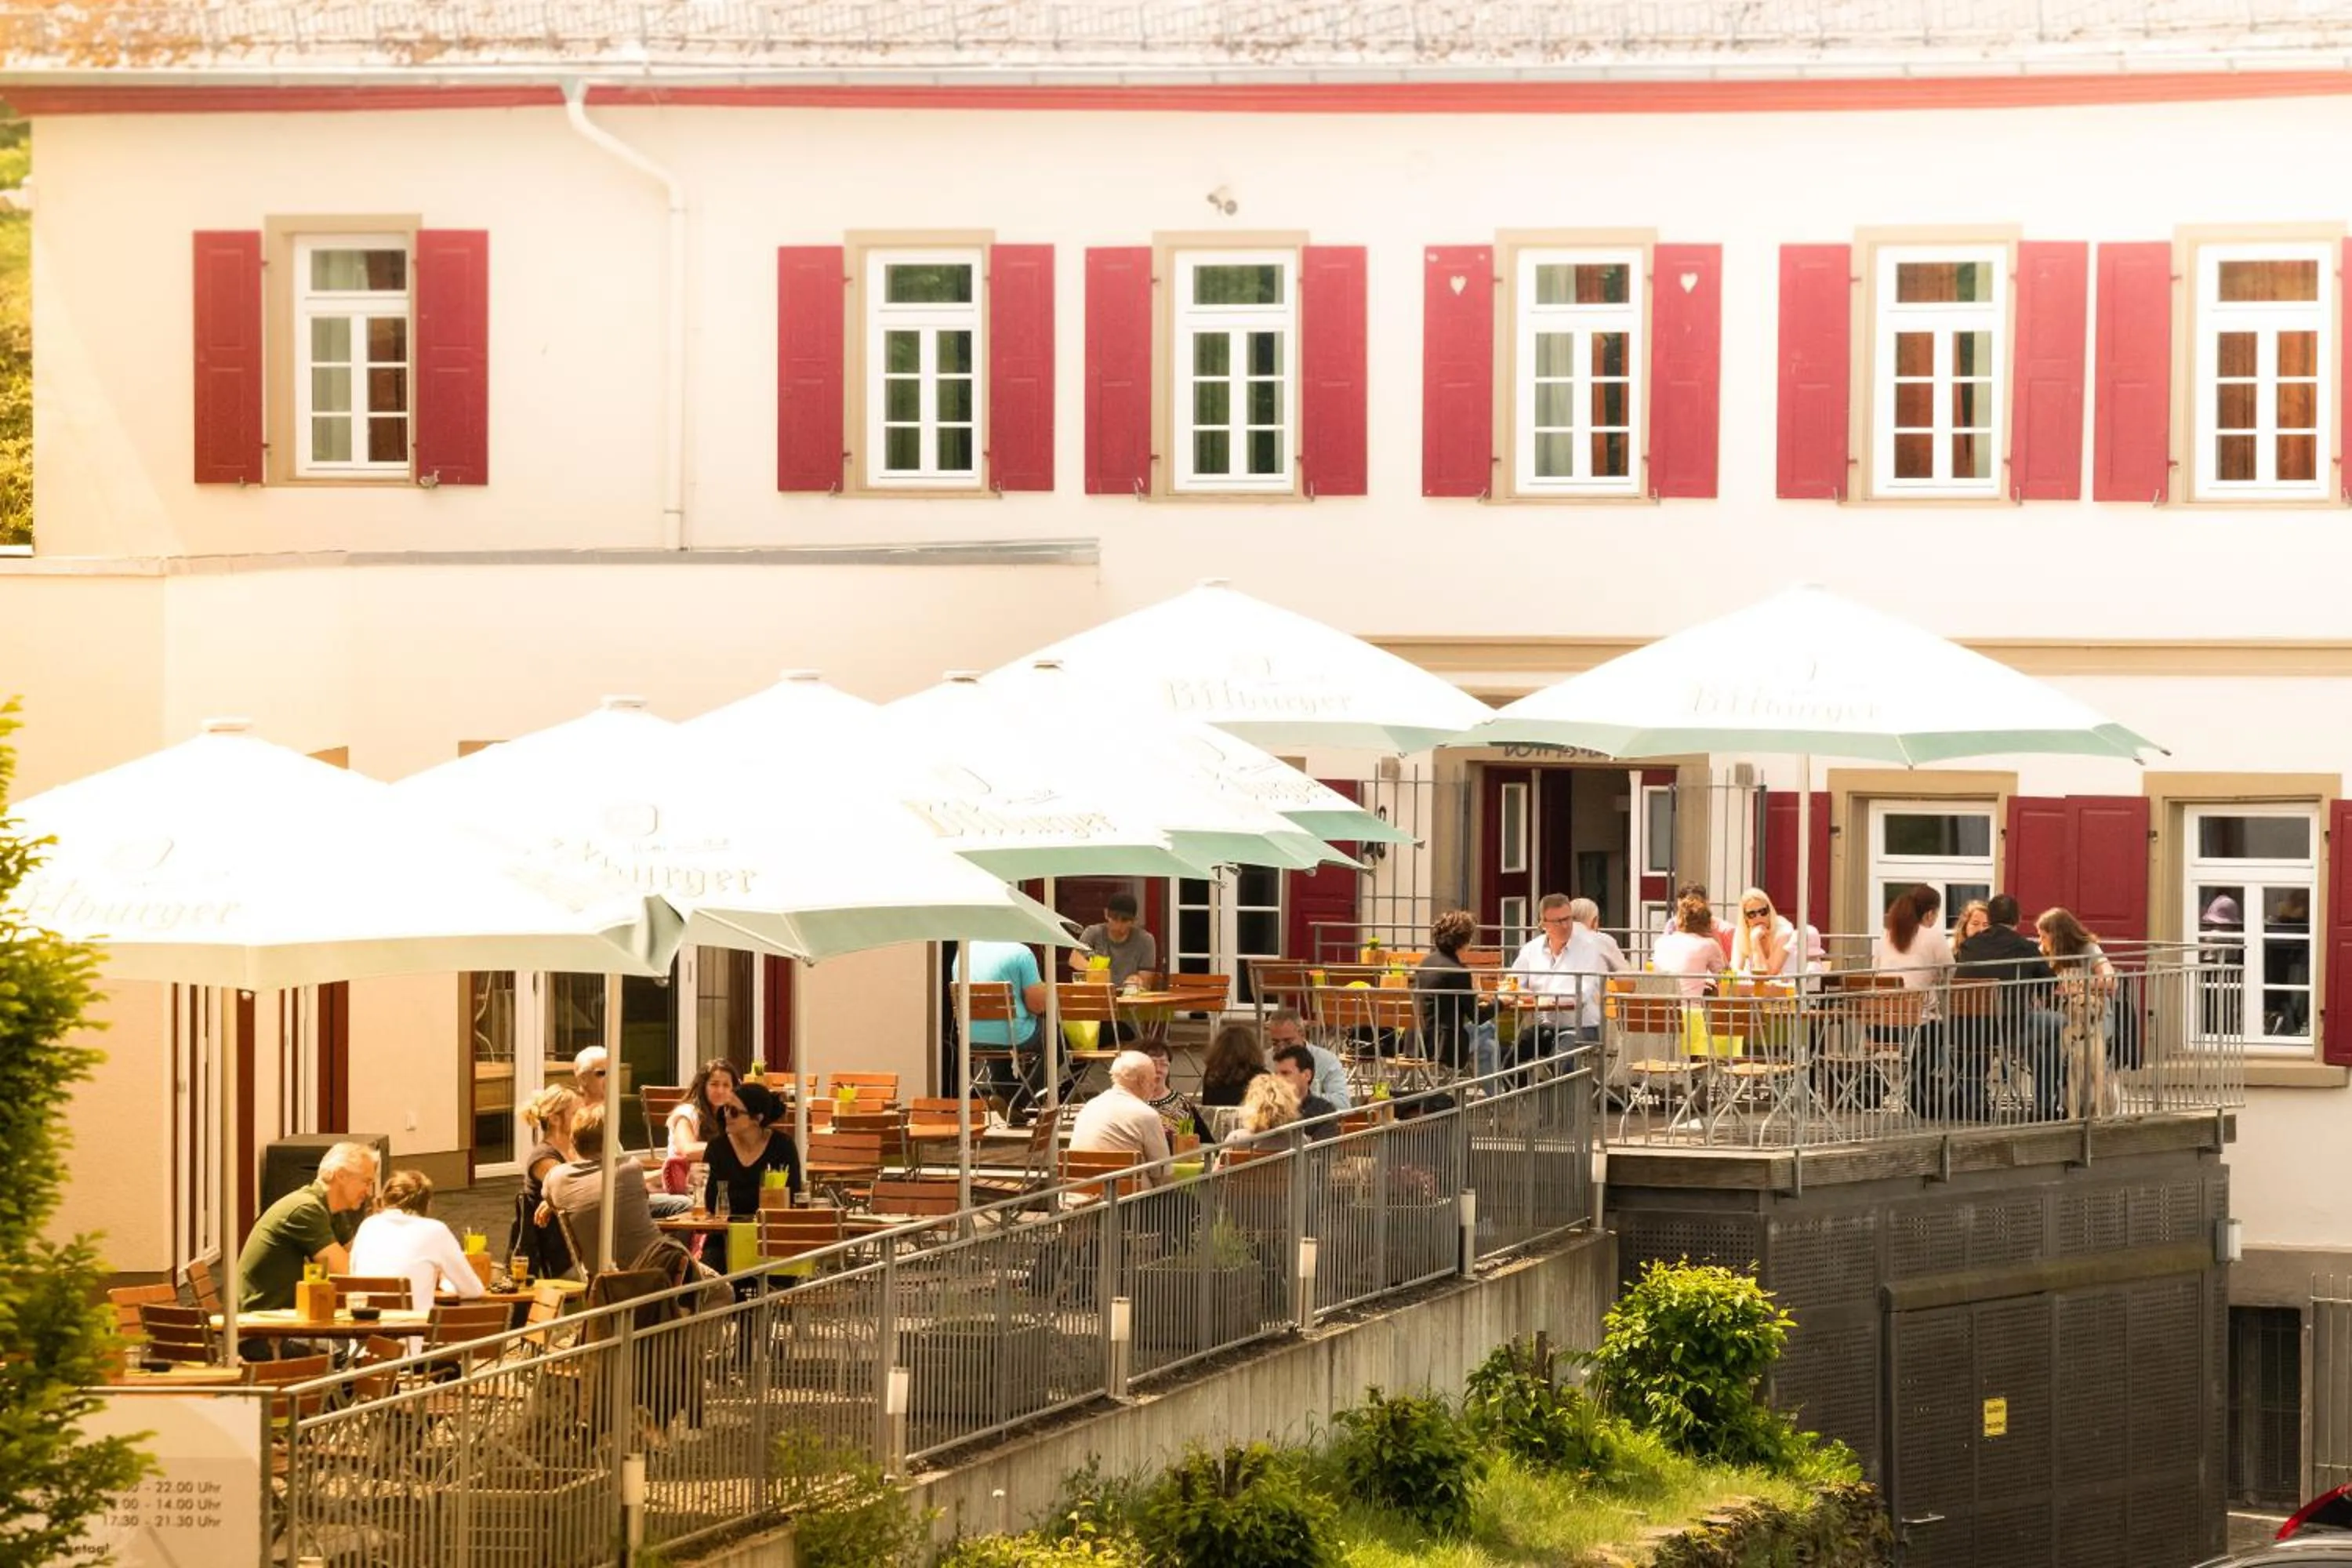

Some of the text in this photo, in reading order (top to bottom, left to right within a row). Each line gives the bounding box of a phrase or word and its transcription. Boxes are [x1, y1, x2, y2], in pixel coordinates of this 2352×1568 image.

[198, 1480, 221, 1494] Uhr
[157, 1498, 194, 1510] 14.00
[198, 1497, 221, 1510] Uhr
[155, 1515, 194, 1527] 21.30
[198, 1514, 221, 1527] Uhr
